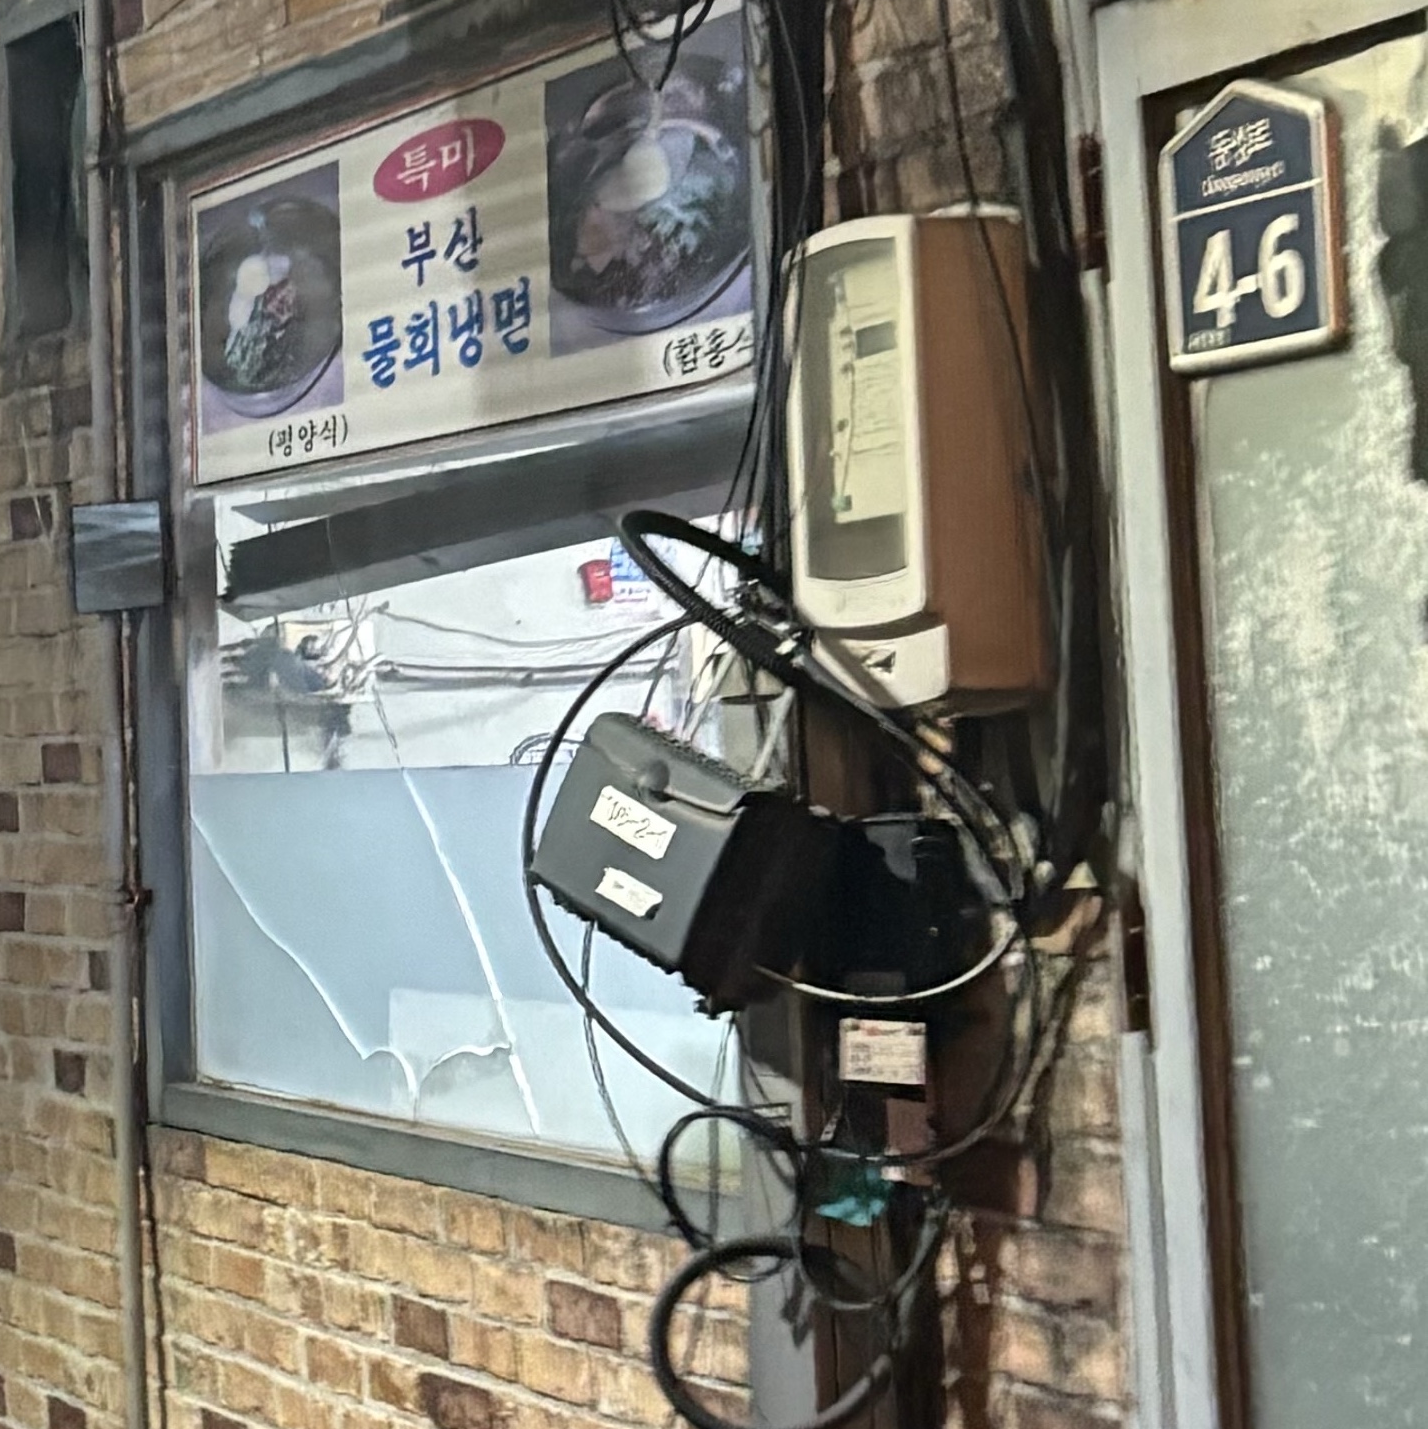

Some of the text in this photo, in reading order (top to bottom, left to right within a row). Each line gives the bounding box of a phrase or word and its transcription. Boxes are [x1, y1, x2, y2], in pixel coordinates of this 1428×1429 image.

[398, 126, 474, 192] 특미
[402, 206, 482, 286] 부산
[1193, 214, 1305, 328] 4-6
[363, 276, 531, 388] 물회냉면
